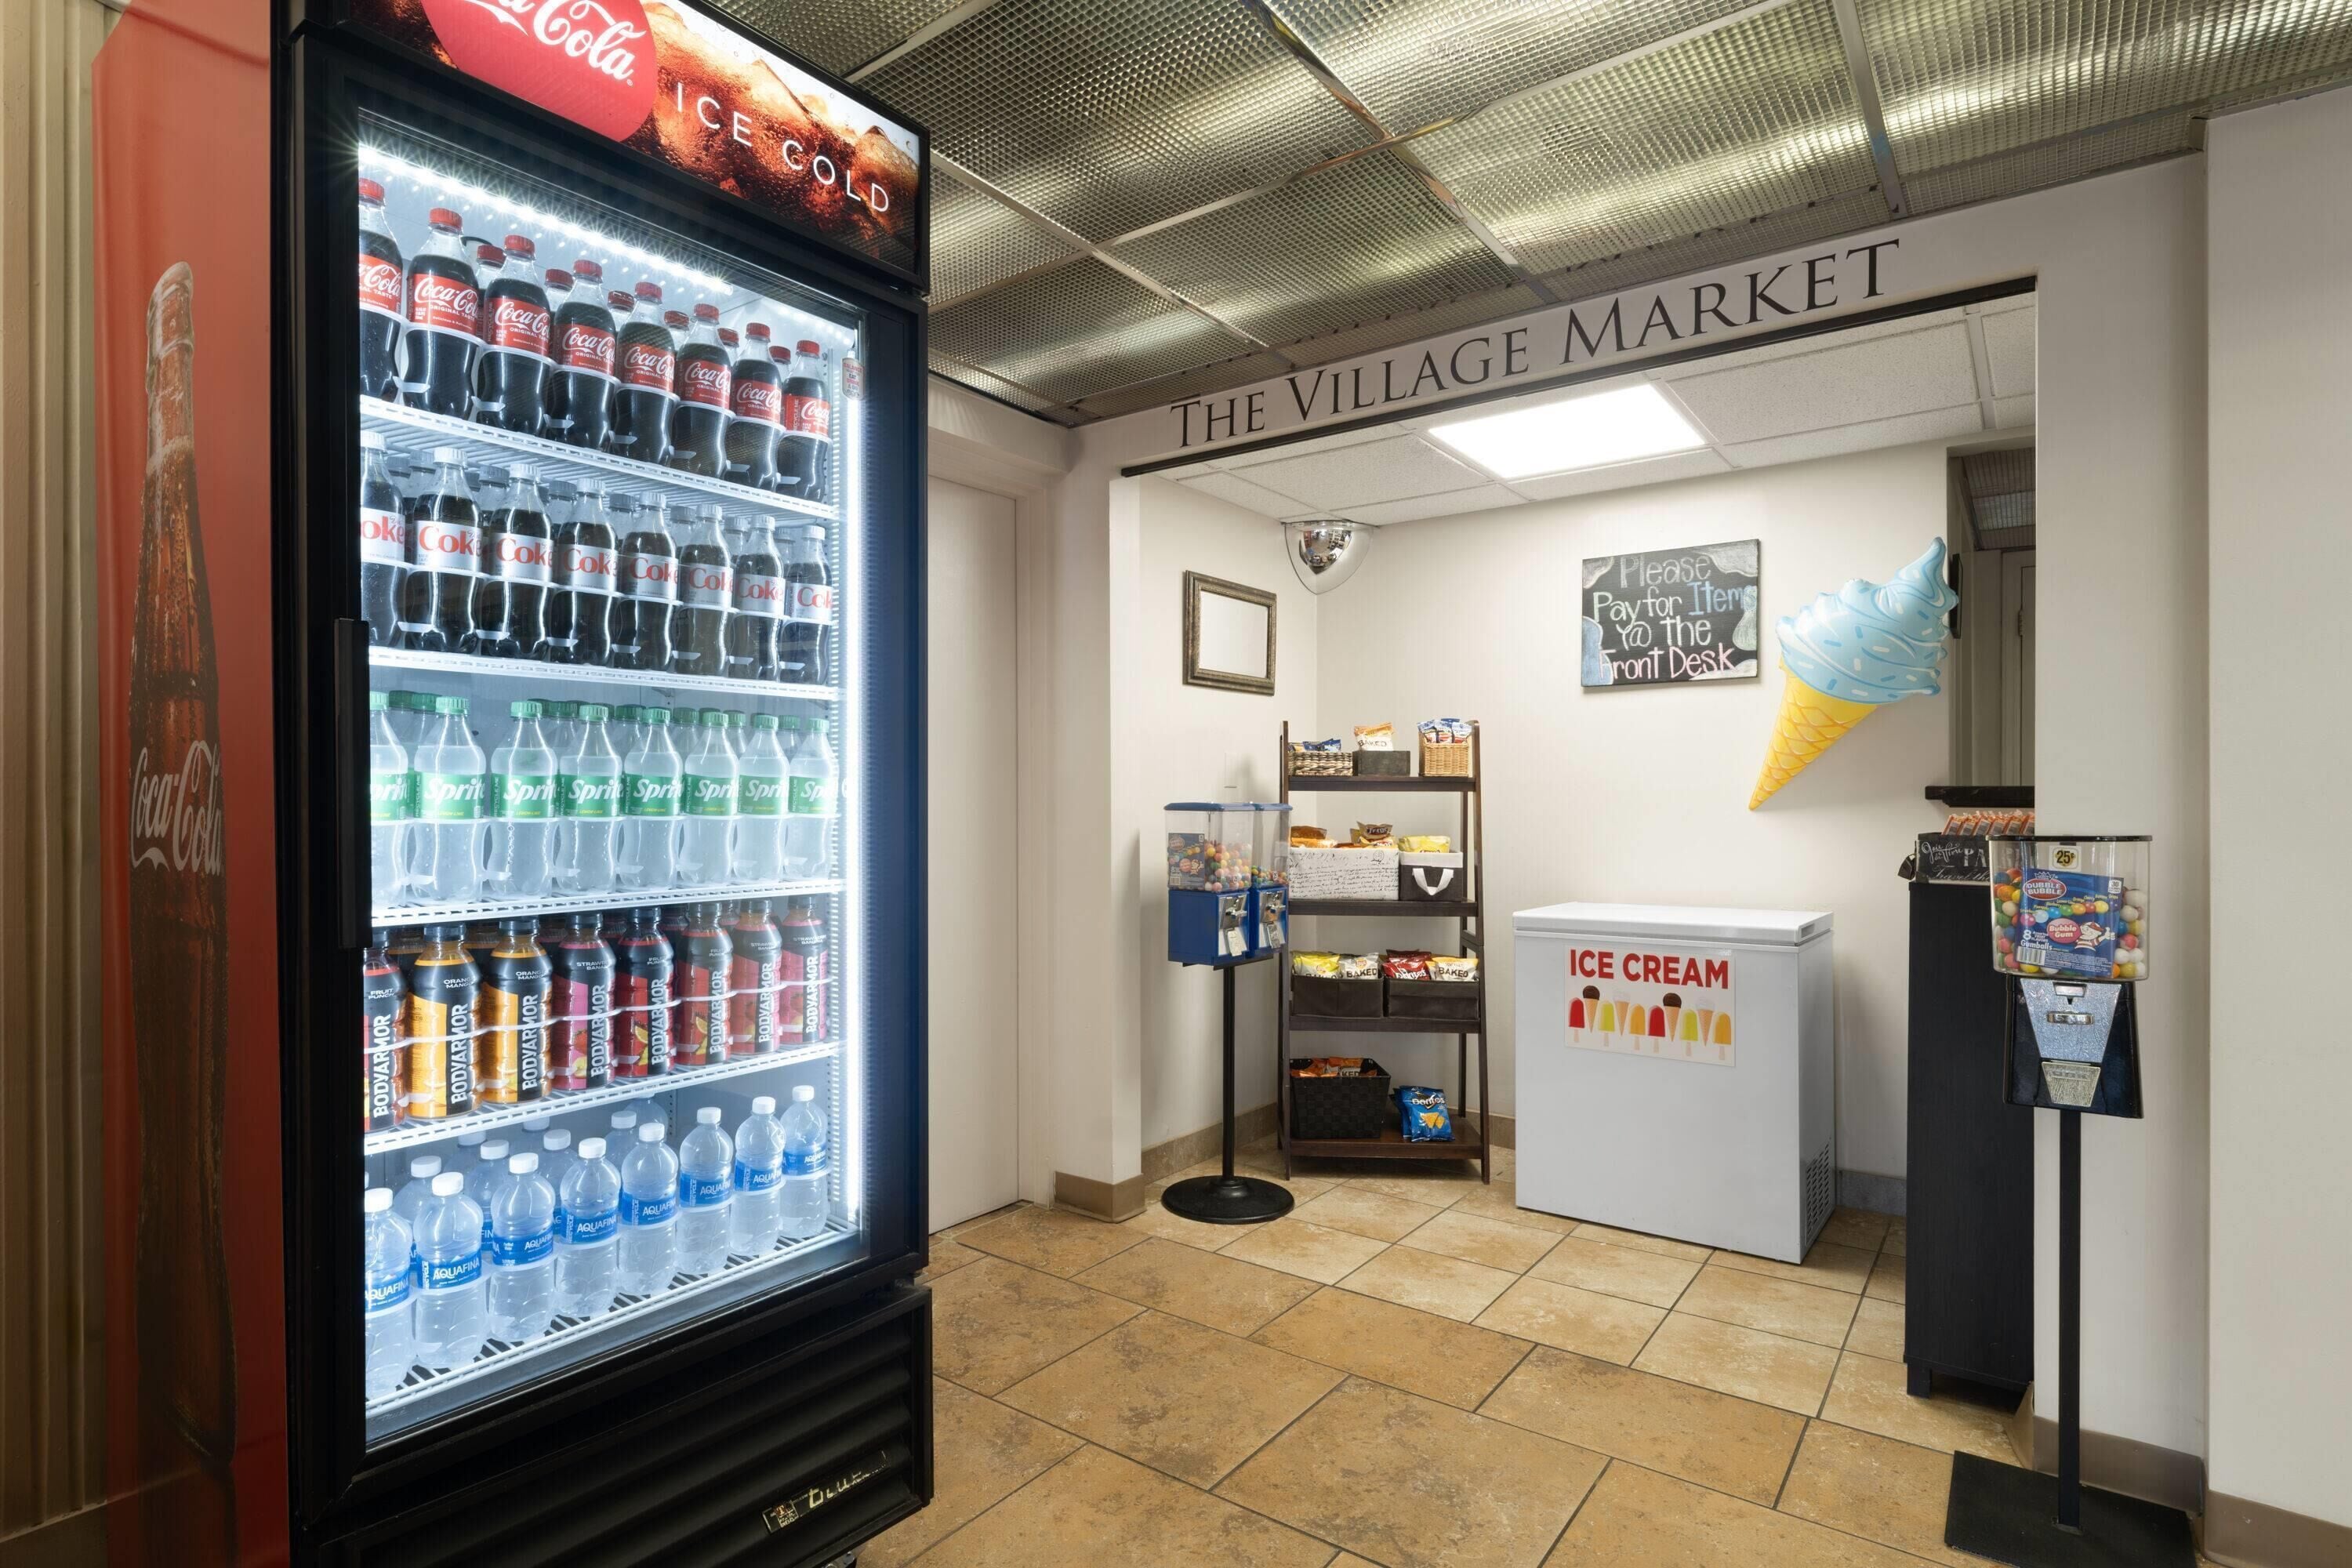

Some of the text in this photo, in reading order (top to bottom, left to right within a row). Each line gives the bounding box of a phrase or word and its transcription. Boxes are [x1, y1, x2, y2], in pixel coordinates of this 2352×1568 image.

[677, 82, 890, 213] ICE COLD
[414, 277, 479, 317] Coca-Col
[429, 304, 460, 316] ORIGINAL
[494, 301, 550, 338] Coca-Co
[510, 327, 537, 338] ORIGINAL
[562, 327, 616, 362] Coca-Co
[1170, 238, 1900, 448] THE VILLAGE MARKET
[361, 516, 405, 545] oke
[419, 525, 482, 557] Coke
[1620, 554, 1711, 588] Please
[1593, 591, 1642, 632] Pay
[1642, 586, 1683, 617] for
[1599, 642, 1737, 681] Front Desk
[503, 779, 557, 805] Sprit
[633, 779, 684, 803] Sprit
[131, 740, 222, 877] Coca-Cola
[2020, 939, 2053, 951] Gumballs
[2023, 929, 2032, 940] 8
[1346, 967, 1377, 978] BAKED
[1438, 967, 1469, 978] BAKED
[1570, 949, 1729, 989] ICE CREAM
[758, 962, 773, 1043] BODYARMOR
[805, 955, 818, 1034] BODYARMOR
[651, 978, 665, 1065] BODYARMOR
[710, 970, 723, 1054] BODYARMOR
[521, 994, 539, 1091] BODYARMOR
[590, 984, 605, 1078] BODYARMOR
[372, 1013, 391, 1118] BODYARMOR
[451, 1003, 469, 1104] BODYARMOR
[1411, 1095, 1446, 1105] Doritos
[699, 1179, 731, 1196] AQUAFIN
[753, 1171, 782, 1184] AQUAFI
[576, 1214, 617, 1233] AQUAFINA
[642, 1197, 677, 1216] AQUAFIN
[524, 1233, 553, 1250] AQUAFIN
[433, 1256, 481, 1280] AQUAFINA
